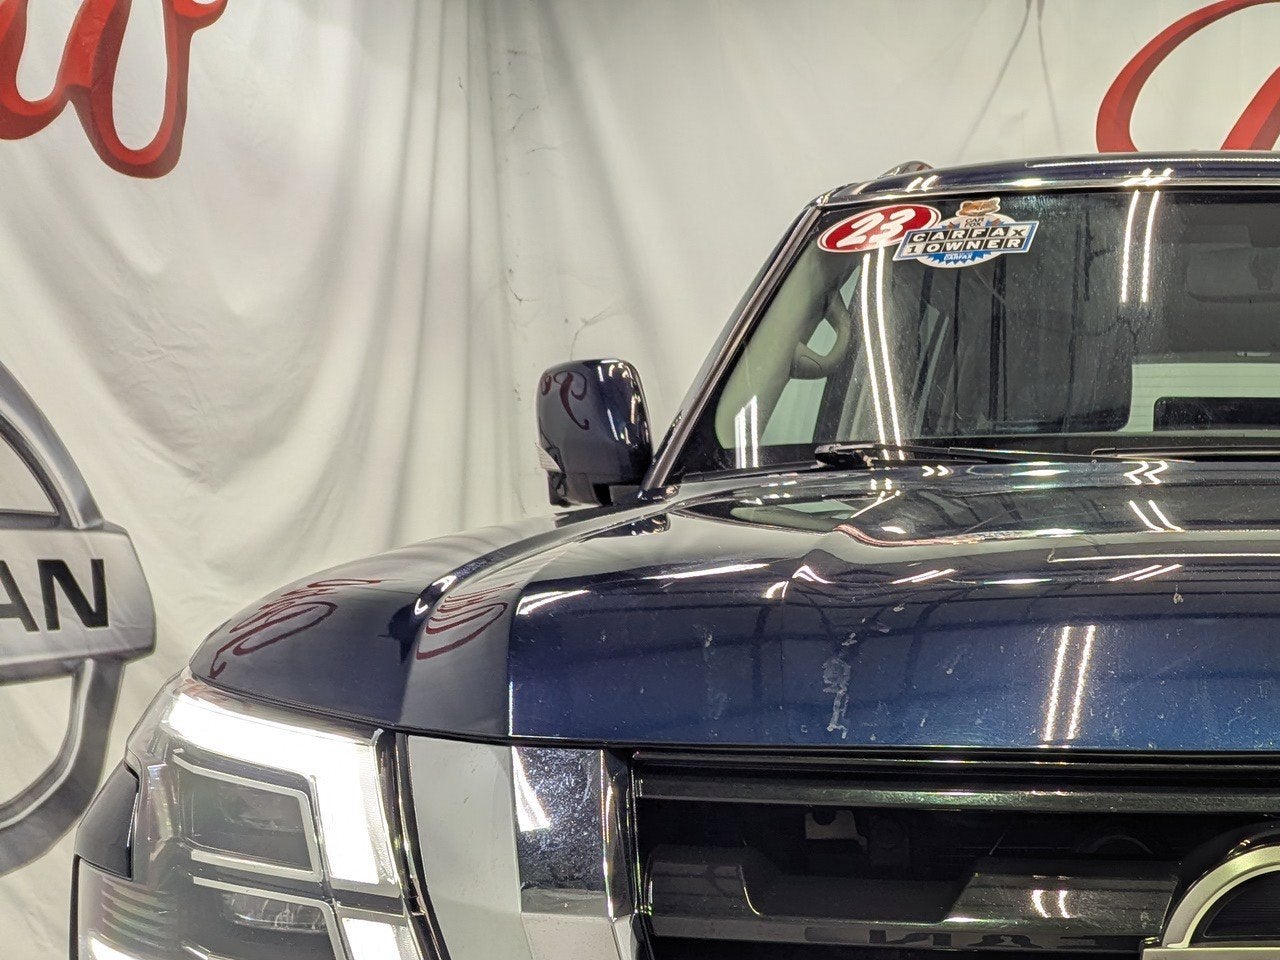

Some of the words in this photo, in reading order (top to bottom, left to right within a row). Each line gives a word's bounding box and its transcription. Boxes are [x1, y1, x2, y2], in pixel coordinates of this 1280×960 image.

[836, 207, 917, 249] 23
[911, 228, 1027, 242] CARFAX
[925, 239, 1022, 252] OWNER
